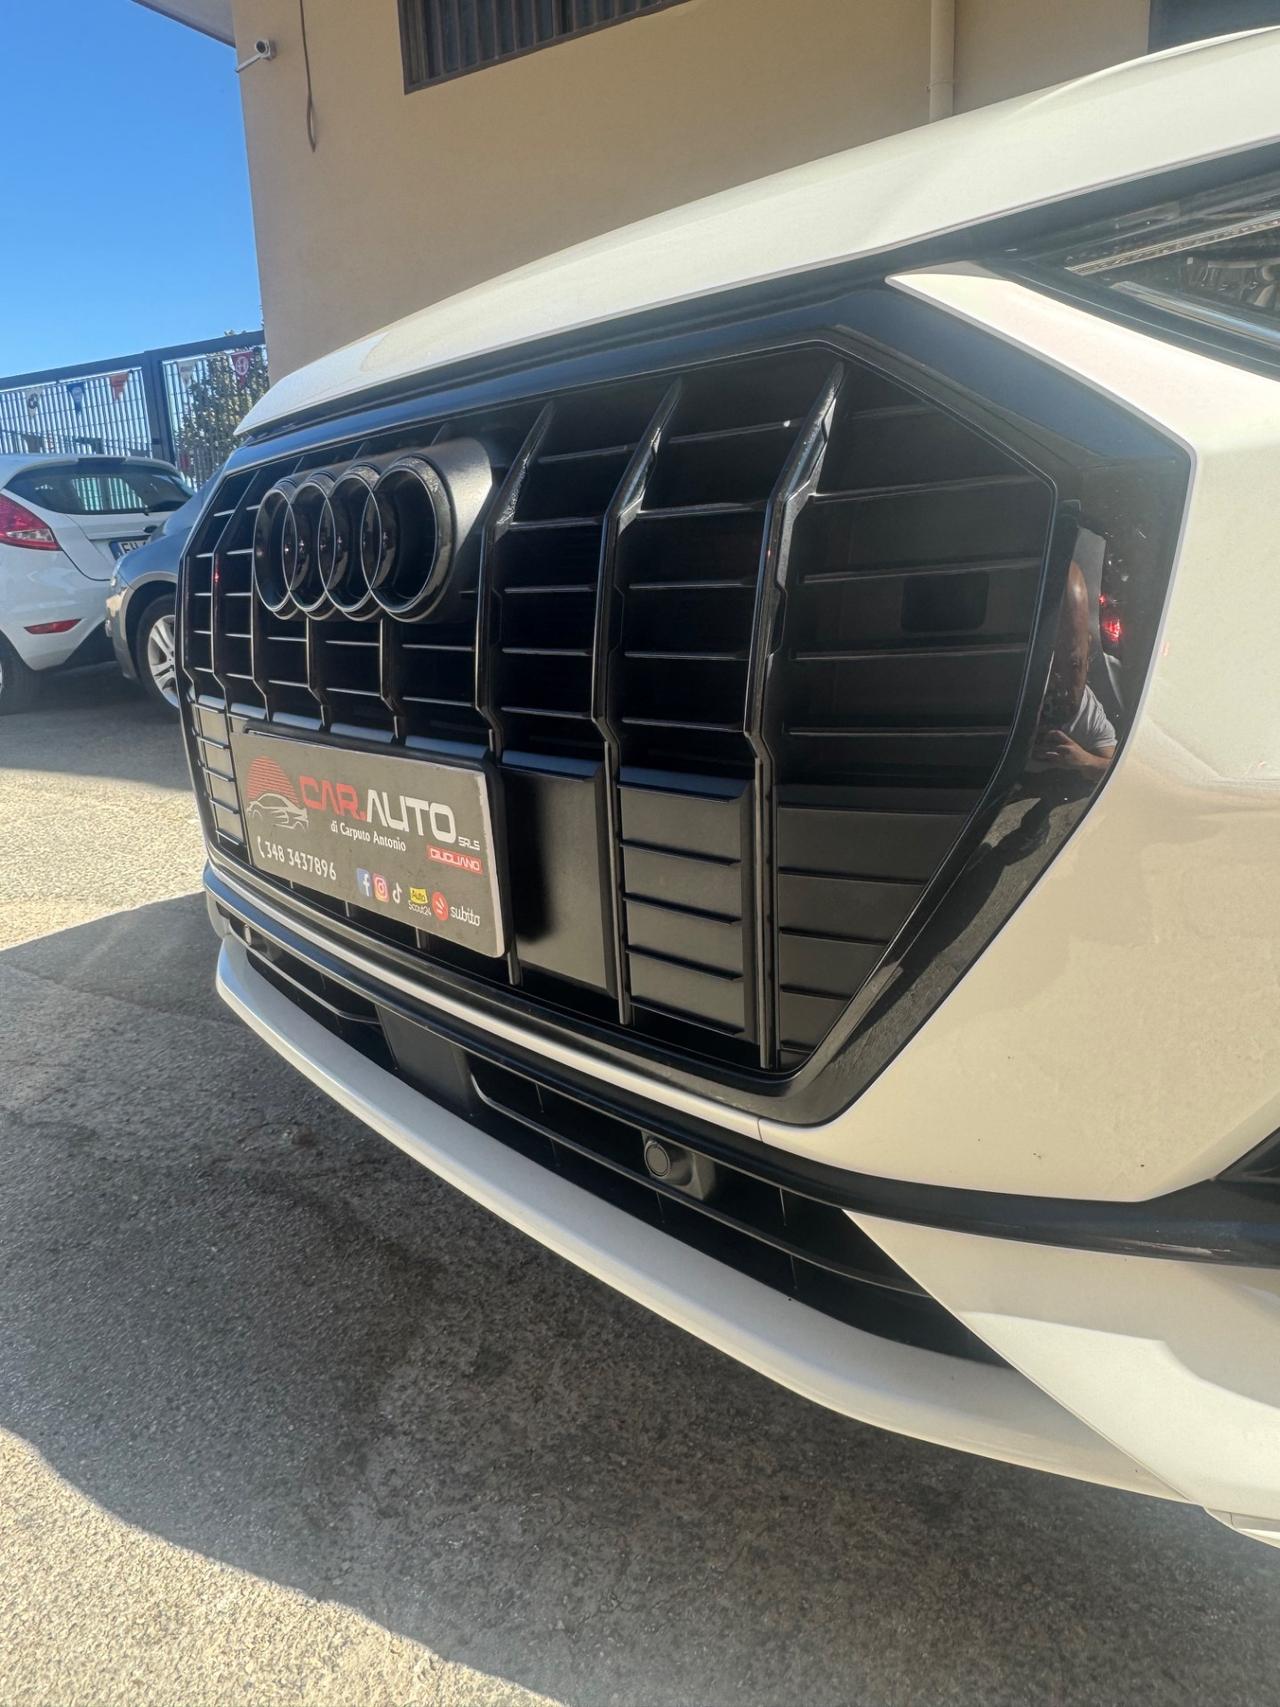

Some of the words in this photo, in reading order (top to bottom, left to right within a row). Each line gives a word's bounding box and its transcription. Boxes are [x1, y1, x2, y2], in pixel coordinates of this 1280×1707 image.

[330, 820, 338, 833] di
[340, 822, 370, 842] Carputo
[373, 831, 406, 852] Antonio
[265, 841, 285, 863] 348
[287, 848, 337, 881] 3437896
[450, 905, 480, 927] subito
